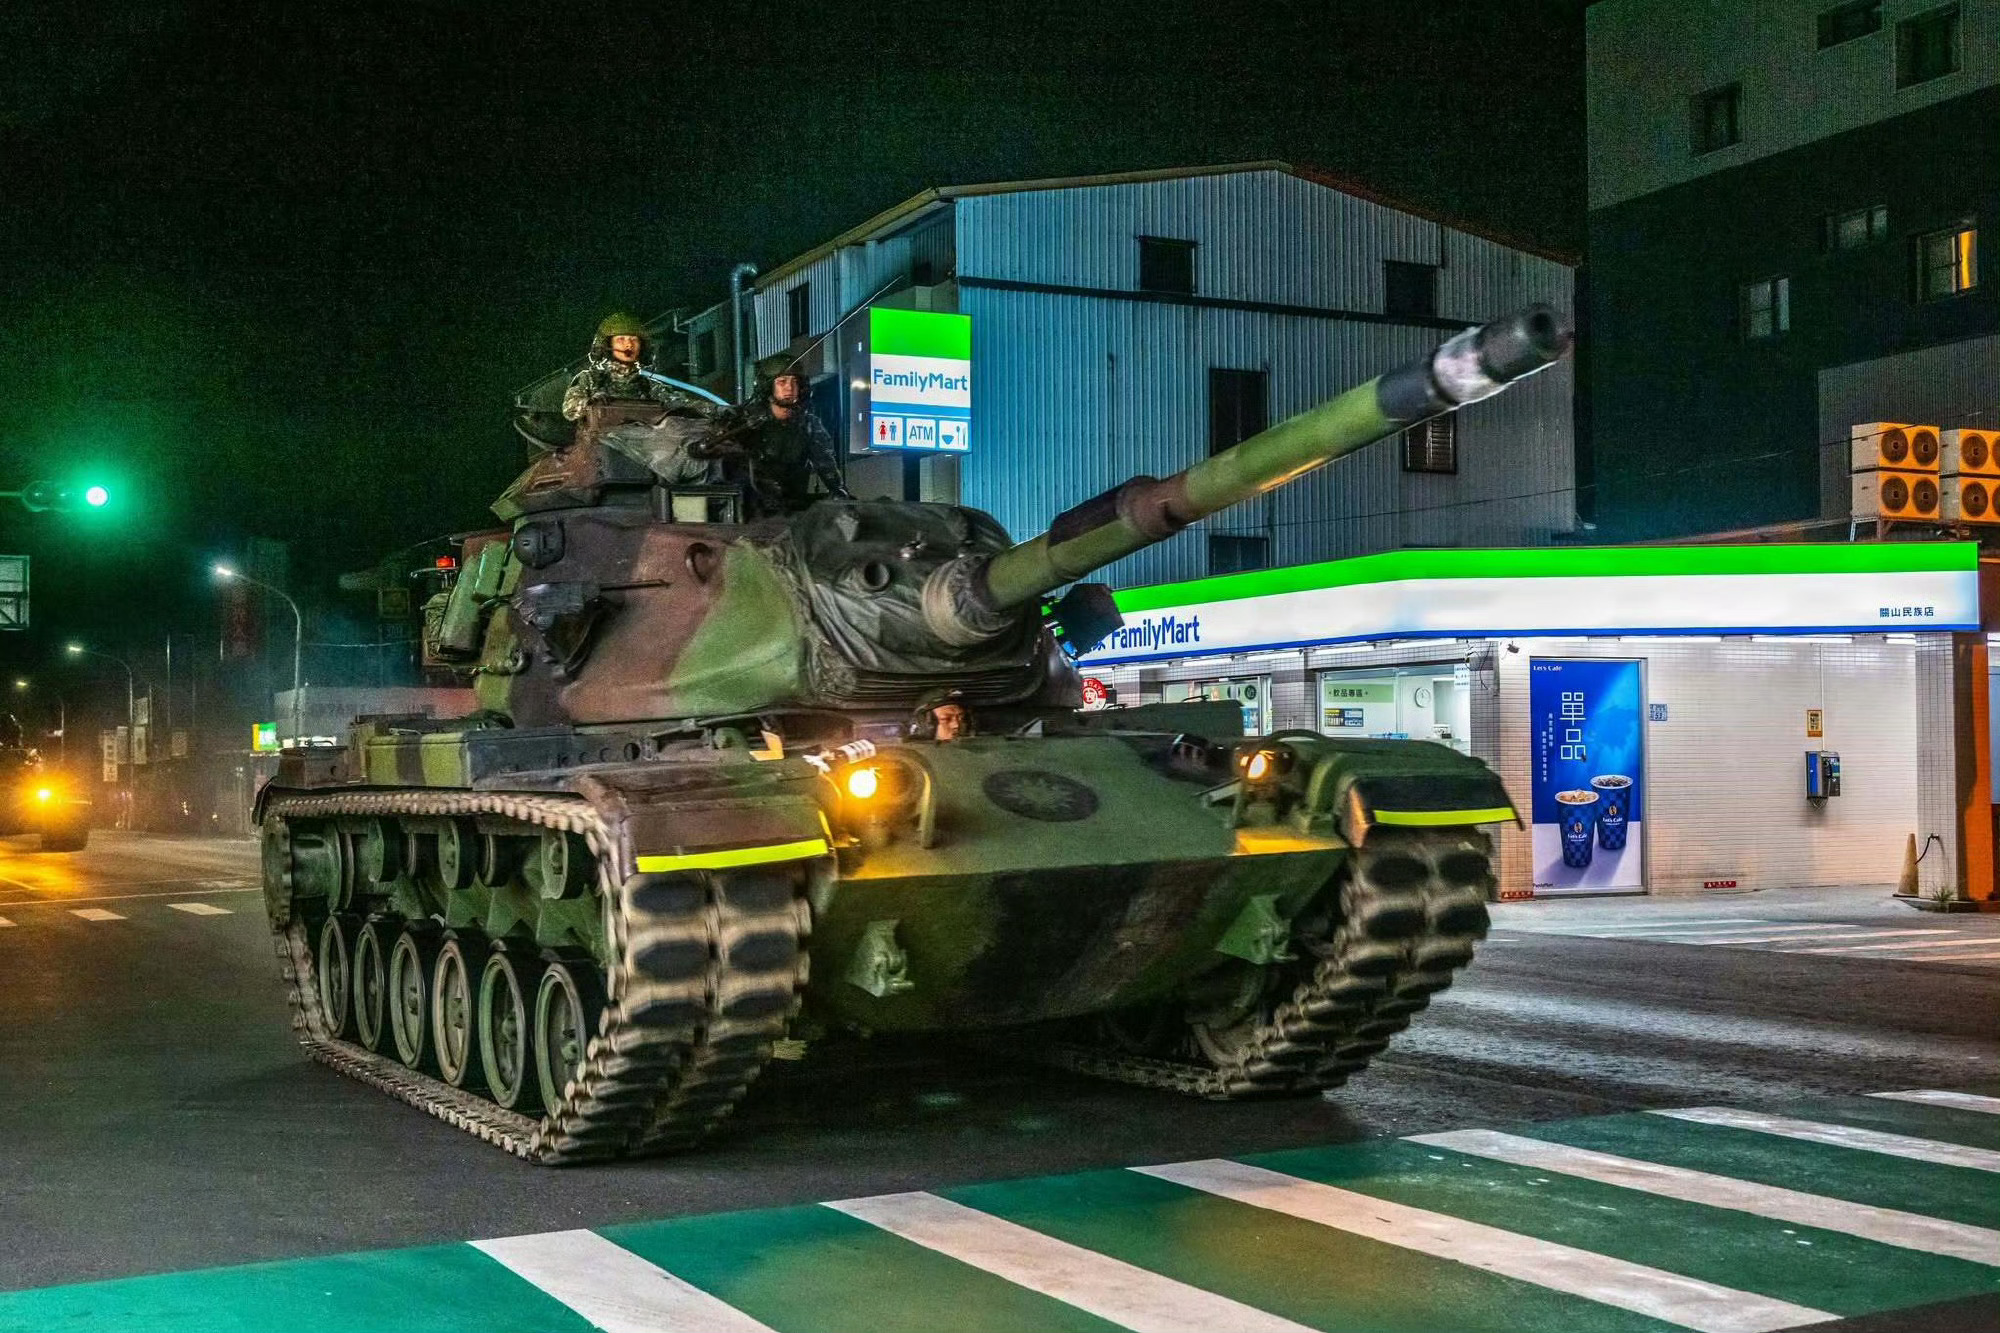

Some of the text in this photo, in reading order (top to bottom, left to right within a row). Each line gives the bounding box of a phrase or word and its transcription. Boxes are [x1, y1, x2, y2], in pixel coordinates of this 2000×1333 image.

[873, 368, 968, 392] FamilyMart
[909, 425, 933, 441] ATM
[1879, 606, 1934, 618] 關山民族店
[1111, 615, 1200, 651] FamilyMart
[1560, 692, 1587, 760] 單品
